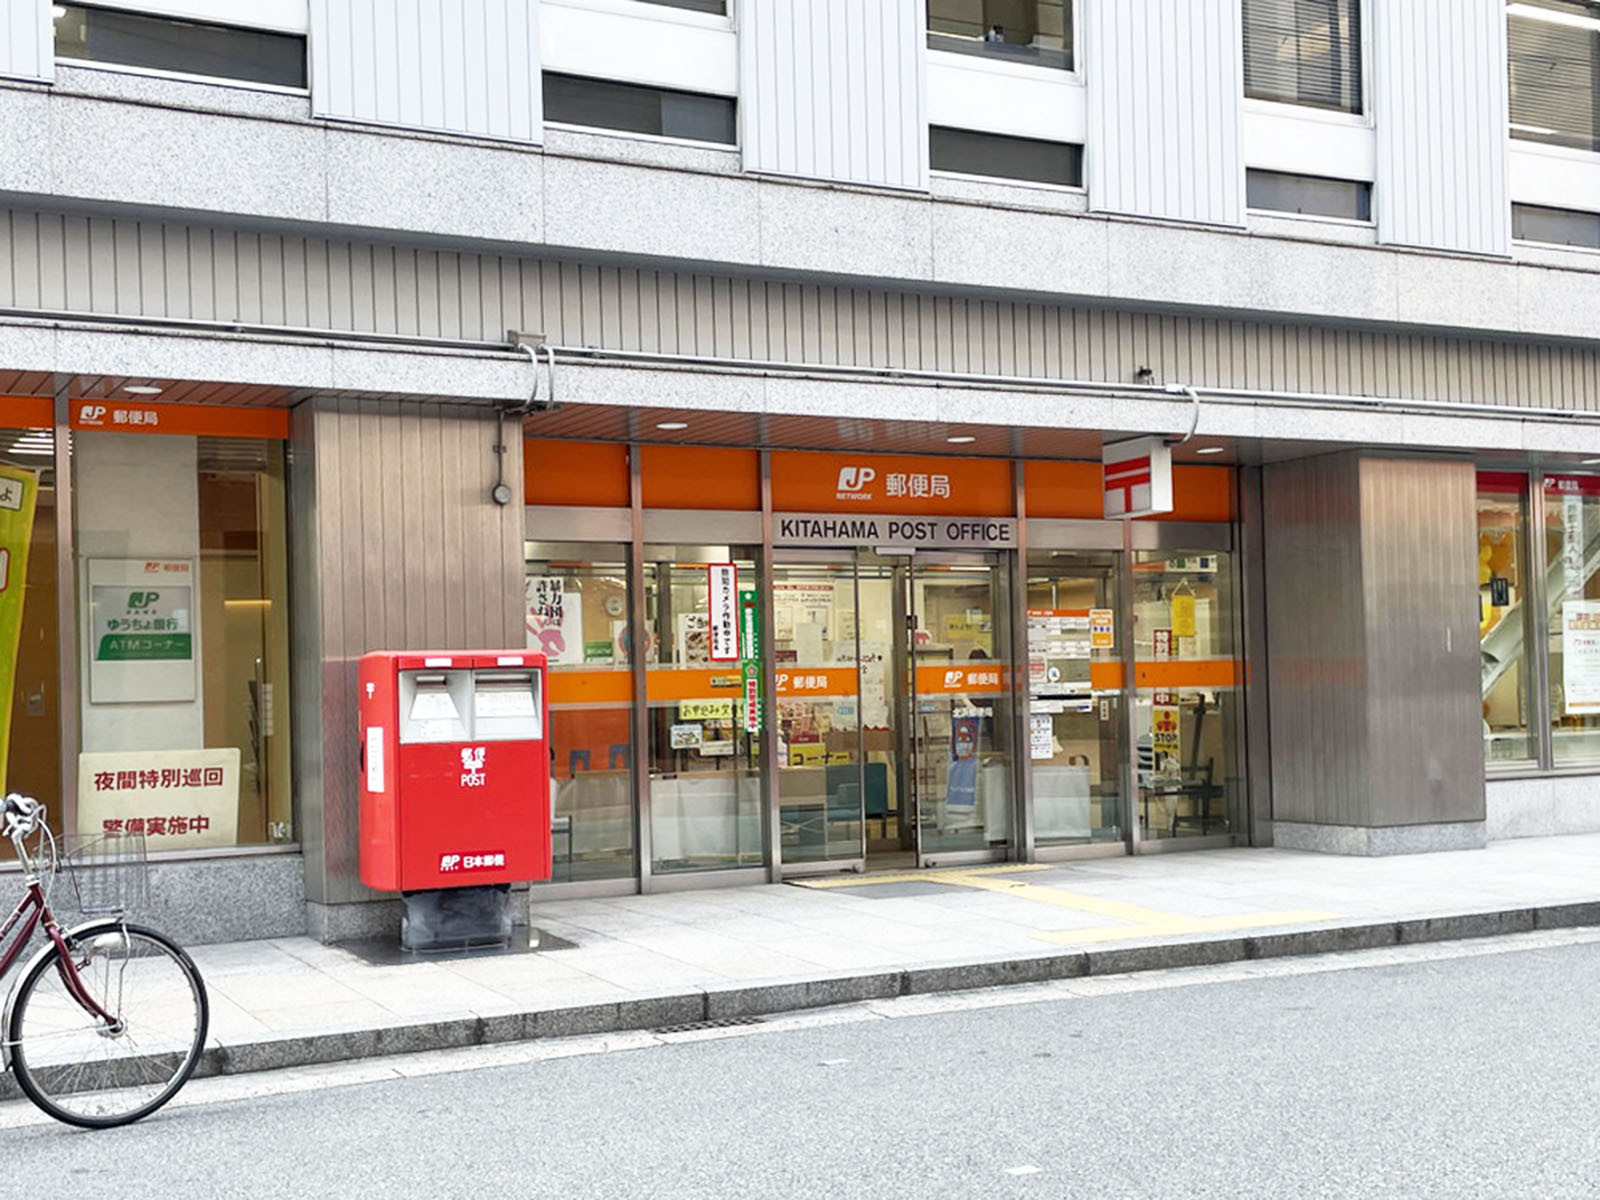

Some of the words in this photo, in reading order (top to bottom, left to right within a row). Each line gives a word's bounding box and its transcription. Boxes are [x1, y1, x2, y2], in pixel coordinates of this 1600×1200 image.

[113, 409, 158, 426] 郵便局
[885, 473, 951, 499] 郵便局
[780, 519, 879, 540] KITAHAMA
[888, 521, 938, 541] POST
[946, 522, 1011, 542] OFFICE
[107, 617, 179, 632] ゆうちょ銀行
[109, 639, 185, 651] ATMコーナー
[1154, 732, 1178, 743] STOP
[93, 766, 224, 793] 夜間特別巡回
[460, 773, 487, 787] POST
[102, 814, 210, 840] 警備実施中
